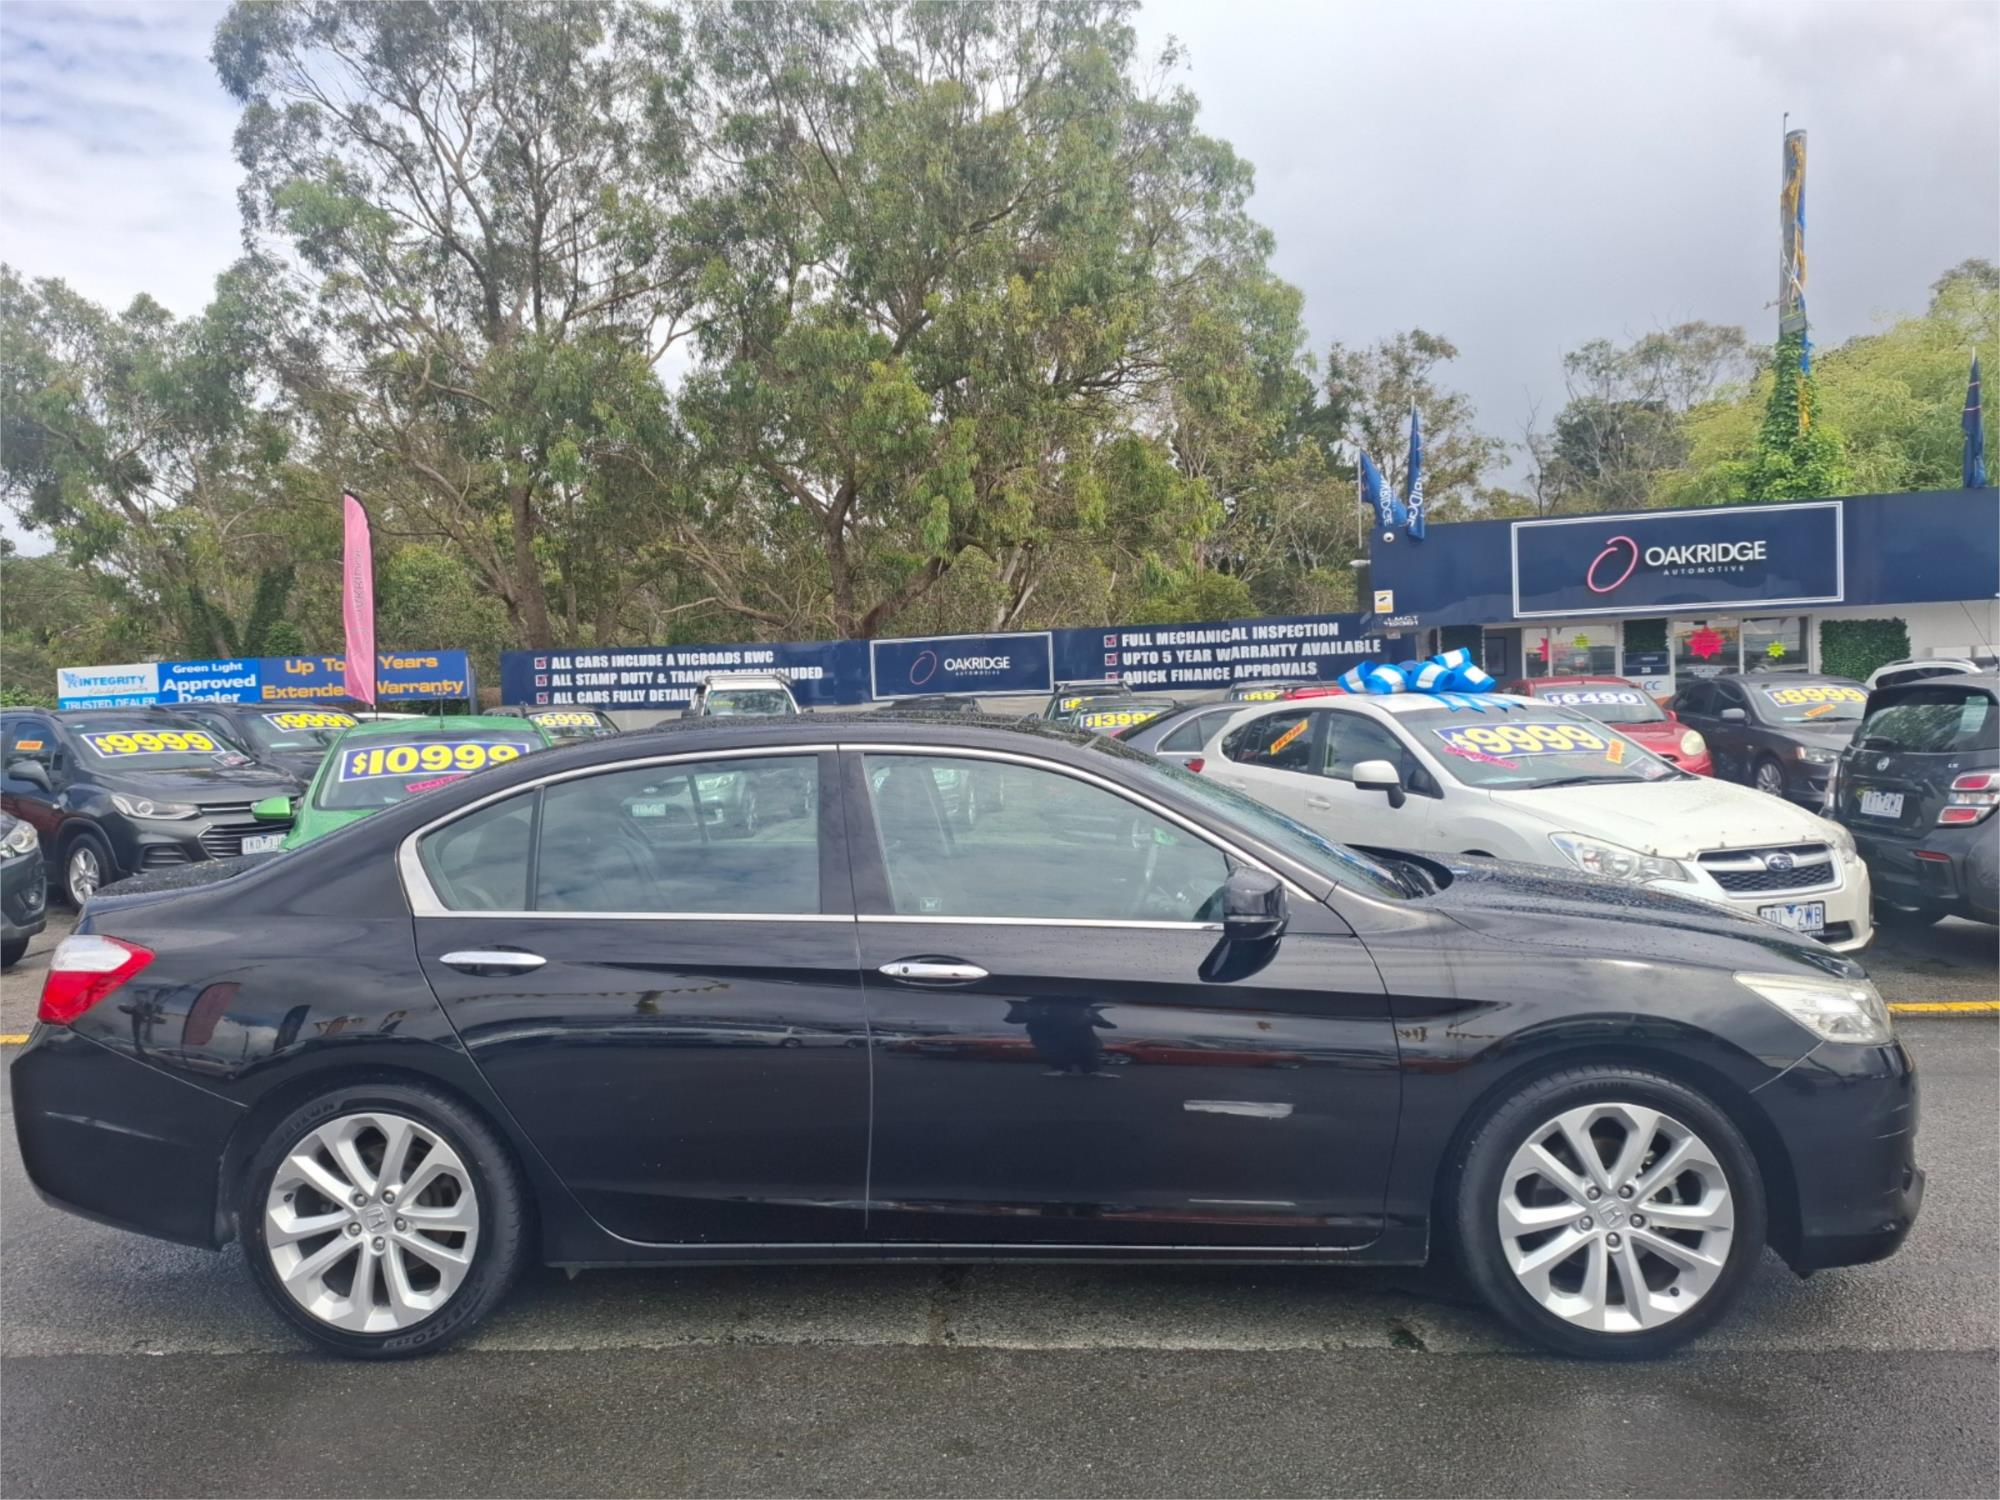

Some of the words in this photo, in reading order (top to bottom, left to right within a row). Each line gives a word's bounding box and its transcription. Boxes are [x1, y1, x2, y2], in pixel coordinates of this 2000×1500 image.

[1645, 540, 1767, 566] OAKRIDGE
[1663, 565, 1745, 576] AUTOMOTIVE
[1122, 633, 1152, 647] FULL
[1156, 627, 1248, 645] MECHANICAL
[1252, 622, 1339, 639] INSPECTION
[552, 655, 572, 669] ALL
[575, 655, 608, 668] CARS
[611, 654, 663, 667] INCLUDE
[666, 655, 675, 667] A
[677, 653, 741, 666] VICROADS
[744, 651, 774, 664] RWC
[1122, 651, 1159, 665] UPTO
[1163, 651, 1172, 663] 5
[1176, 649, 1212, 663] YEAR
[1216, 643, 1298, 661] WARRANTY
[1301, 639, 1381, 656] AVAILABLE
[173, 664, 209, 674] Green
[212, 662, 242, 673] Light
[285, 659, 315, 675] Up
[322, 657, 346, 671] To
[378, 655, 439, 669] Years
[944, 656, 1011, 670] OAKRIDGE
[552, 674, 572, 686] ALL
[576, 672, 618, 685] STAMP
[621, 672, 653, 684] DUTY
[657, 673, 667, 683] &
[1123, 670, 1167, 683] QUICK
[1171, 667, 1230, 681] FINANCE
[1234, 661, 1317, 678] APPROVALS
[79, 675, 145, 687] INTEGRITY
[162, 674, 256, 693] Approved
[261, 682, 347, 699] Extende
[553, 692, 573, 704] ALL
[577, 691, 610, 703] CARS
[613, 690, 645, 702] FULLY
[651, 688, 697, 701] DETAIL
[1551, 692, 1638, 706] $6490
[1773, 687, 1867, 704] $8999
[64, 699, 113, 709] TRUSTED
[115, 697, 156, 707] DEALER
[273, 712, 356, 729] $9999
[95, 732, 214, 753] $9999
[1451, 724, 1605, 754] $9999
[352, 743, 519, 775] $10999
